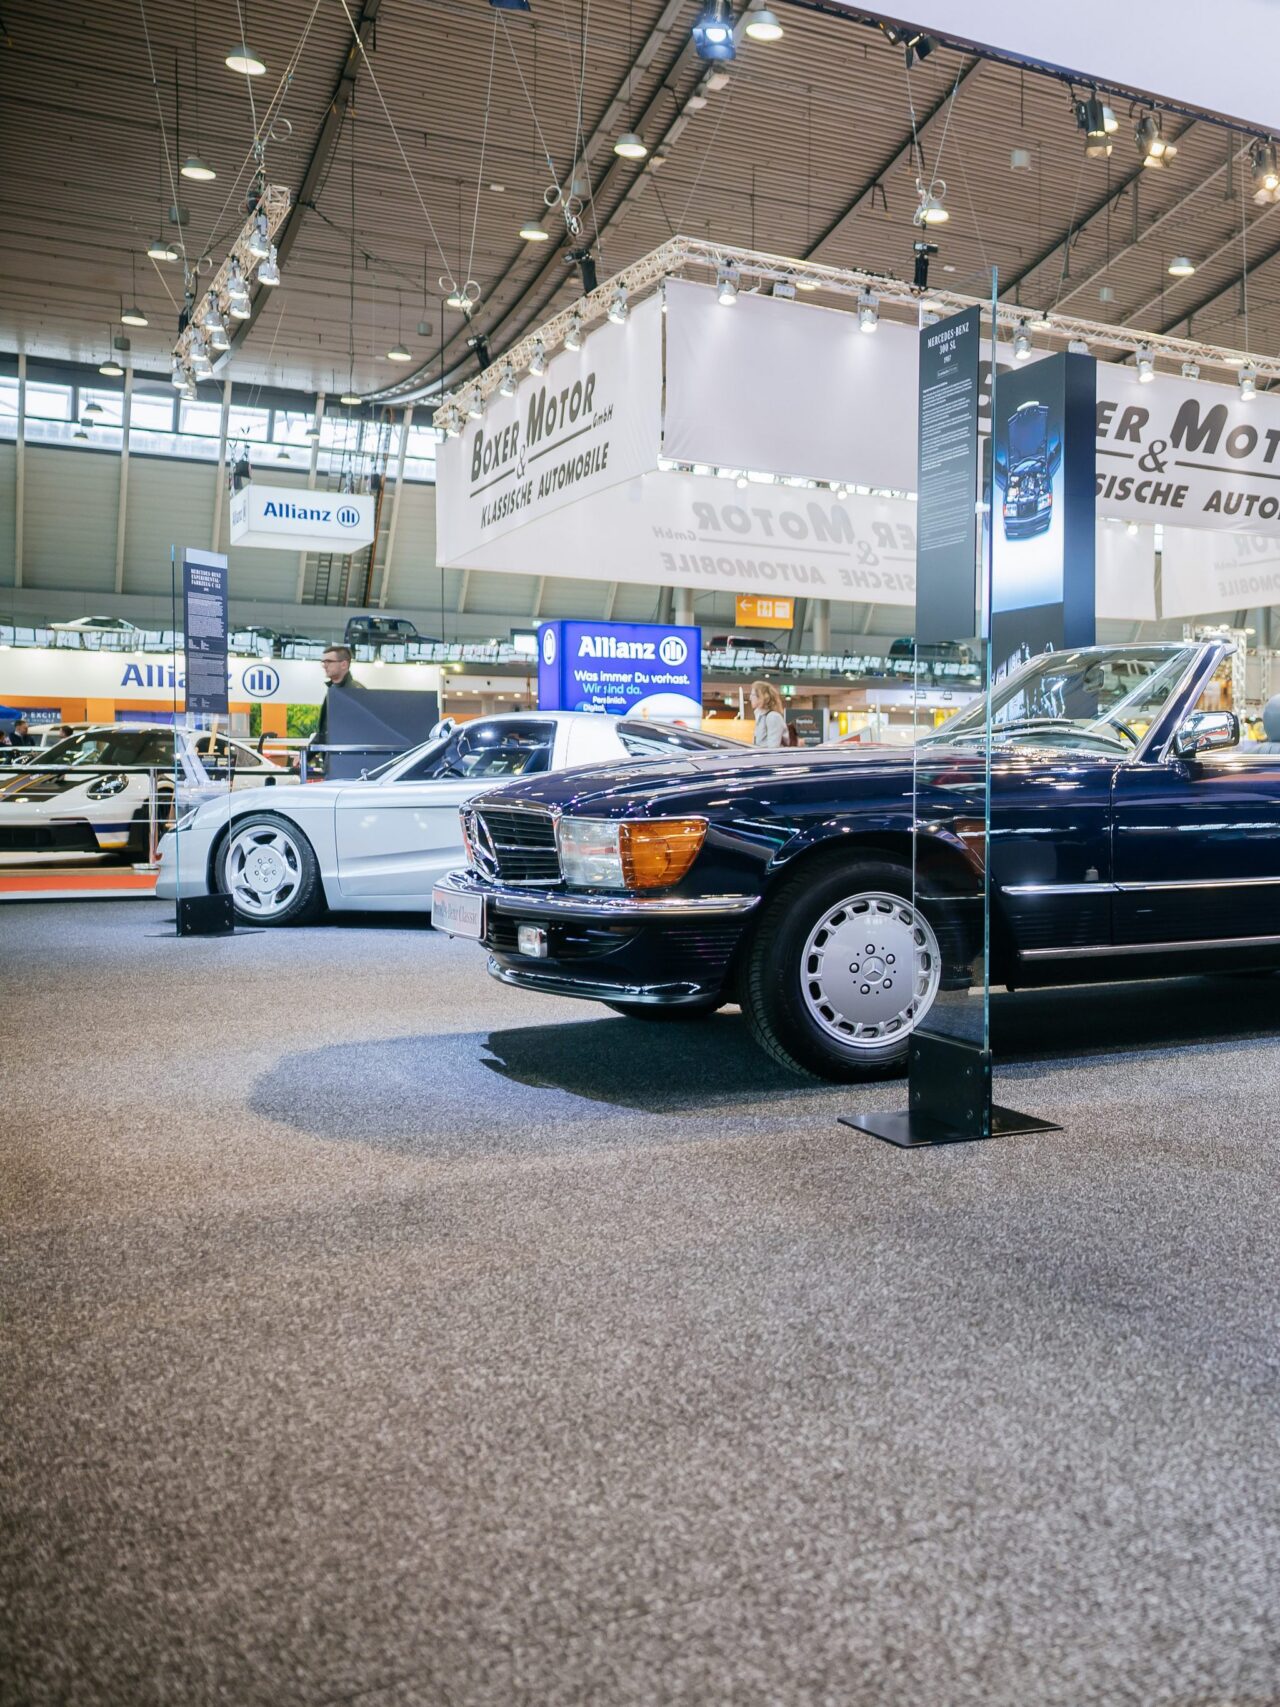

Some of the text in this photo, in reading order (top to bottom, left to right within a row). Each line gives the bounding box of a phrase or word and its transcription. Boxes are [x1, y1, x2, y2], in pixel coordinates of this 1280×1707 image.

[928, 322, 969, 348] MERCEDES-BENZ
[471, 372, 614, 482] BOXER MOTOR GmbH
[516, 444, 526, 480] &
[1138, 439, 1169, 473] &
[480, 441, 609, 529] KLASSISCHE AUTOMOBILE
[1096, 472, 1189, 508] SISCHE
[263, 501, 331, 521] Allianz
[577, 635, 656, 659] Allianz
[121, 663, 231, 689] Alli
[574, 670, 690, 684] Was immer Du vorhast.
[582, 683, 642, 695] Wir sind da.
